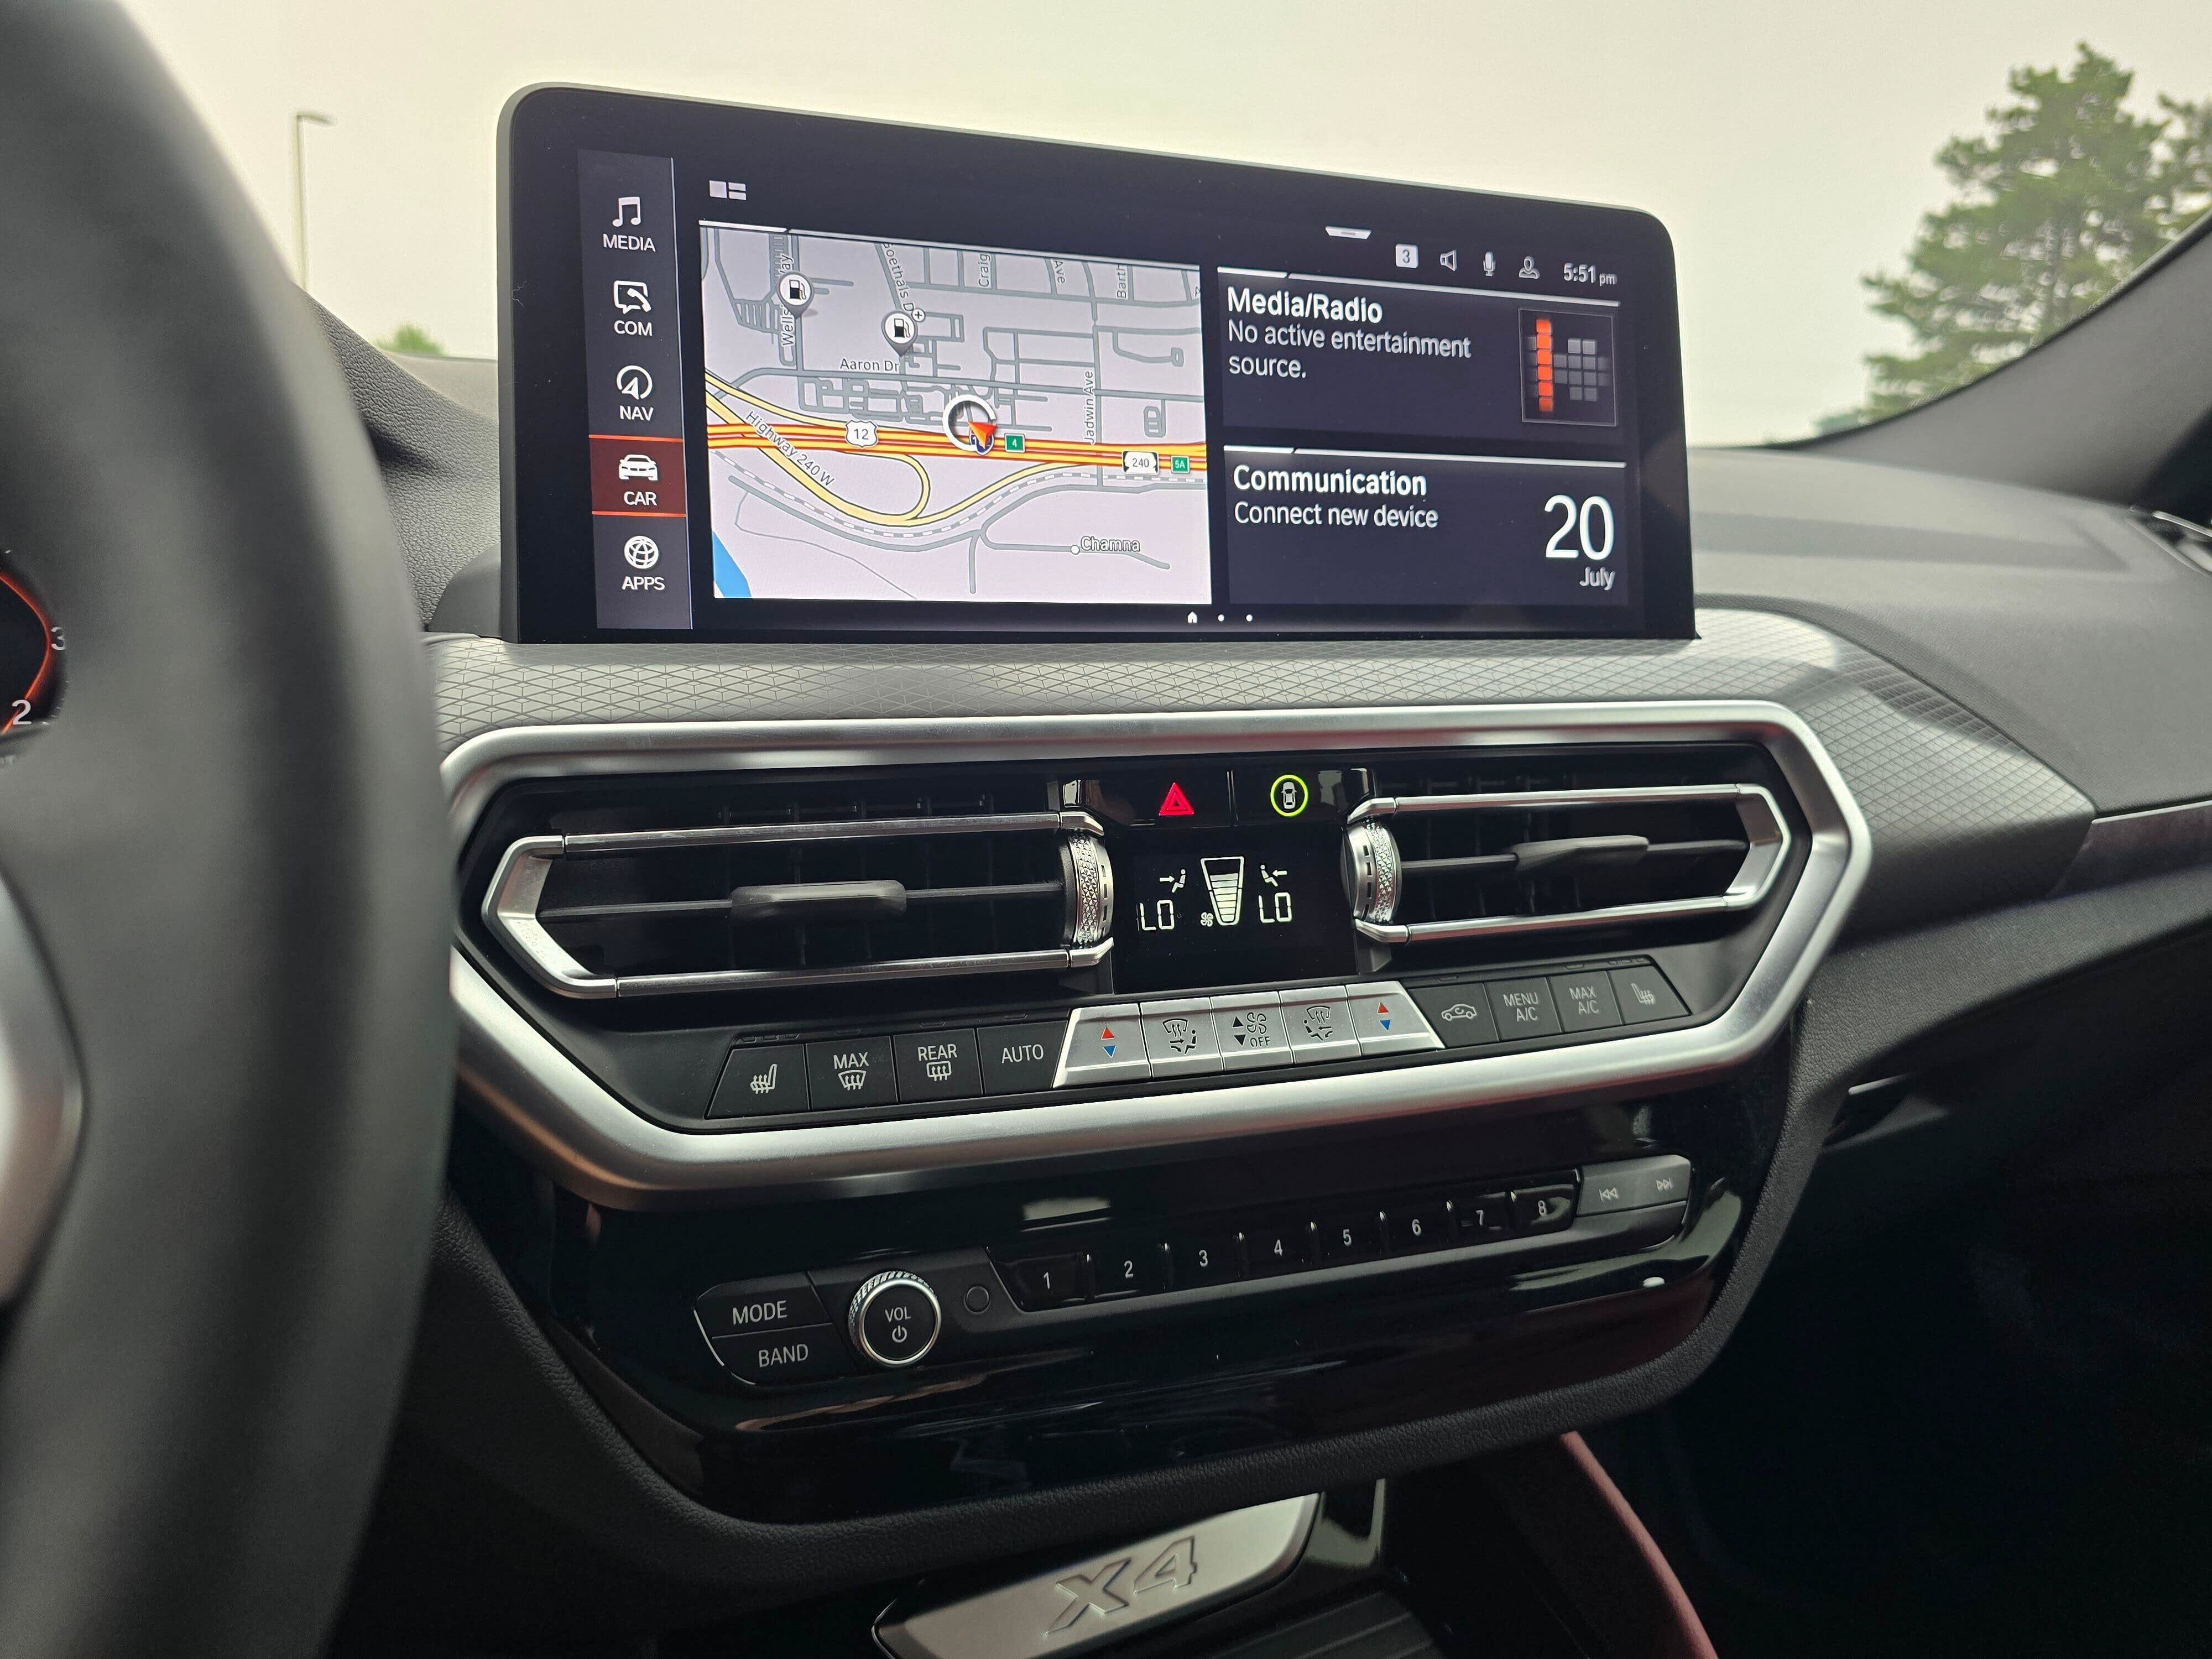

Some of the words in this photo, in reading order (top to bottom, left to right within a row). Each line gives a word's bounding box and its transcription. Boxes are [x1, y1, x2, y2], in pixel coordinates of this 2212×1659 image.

[603, 233, 656, 252] MEDIA
[780, 254, 793, 273] ay
[1402, 249, 1410, 263] 3
[978, 254, 990, 287] Craig
[1054, 260, 1066, 284] Ave
[1563, 263, 1596, 283] 5:51
[1599, 273, 1618, 286] pm
[1227, 286, 1383, 324] Media/Radio
[614, 320, 653, 336] COM
[1228, 319, 1258, 343] No
[1264, 324, 1326, 348] active
[1331, 328, 1472, 358] entertainment
[840, 358, 880, 372] Aaron
[884, 360, 900, 372] Dr
[1229, 355, 1307, 378] source.
[1083, 371, 1094, 395] Ave
[619, 405, 654, 421] NAV
[1084, 398, 1095, 445] Jadwin
[853, 428, 870, 441] 12
[746, 410, 799, 458] Highway
[796, 452, 821, 475] 240
[817, 470, 835, 487] W
[1132, 458, 1150, 468] 240
[1175, 460, 1186, 469] 5A
[1233, 465, 1427, 496] Communication
[623, 491, 658, 506] CAR
[1234, 501, 1323, 525] Connect
[1328, 507, 1369, 526] new
[1374, 504, 1439, 528] device
[1545, 494, 1615, 560] 20
[1080, 535, 1141, 552] Chamna
[621, 576, 665, 591] APPS
[1579, 566, 1616, 591] July
[51, 626, 66, 651] 3
[12, 699, 32, 726] 2
[1503, 992, 1540, 1006] MENU
[1569, 986, 1597, 1000] MAX
[1516, 1006, 1538, 1022] A/C
[1577, 1000, 1599, 1015] A/C
[1250, 1035, 1271, 1049] OFF
[833, 1052, 869, 1070] MAX
[917, 1044, 958, 1061] REAR
[1001, 1044, 1044, 1063] AUTO
[1538, 1199, 1547, 1216] 8
[1475, 1209, 1484, 1226] 7
[1411, 1219, 1422, 1236] 6
[1343, 1229, 1353, 1246] 5
[1273, 1239, 1283, 1256] 4
[1198, 1250, 1208, 1267] 3
[1124, 1260, 1134, 1279] 2
[1043, 1271, 1050, 1288] 1
[732, 1300, 787, 1325] MODE
[885, 1306, 911, 1323] VOL
[758, 1344, 809, 1368] BAND
[1044, 1535, 1198, 1636] X4
